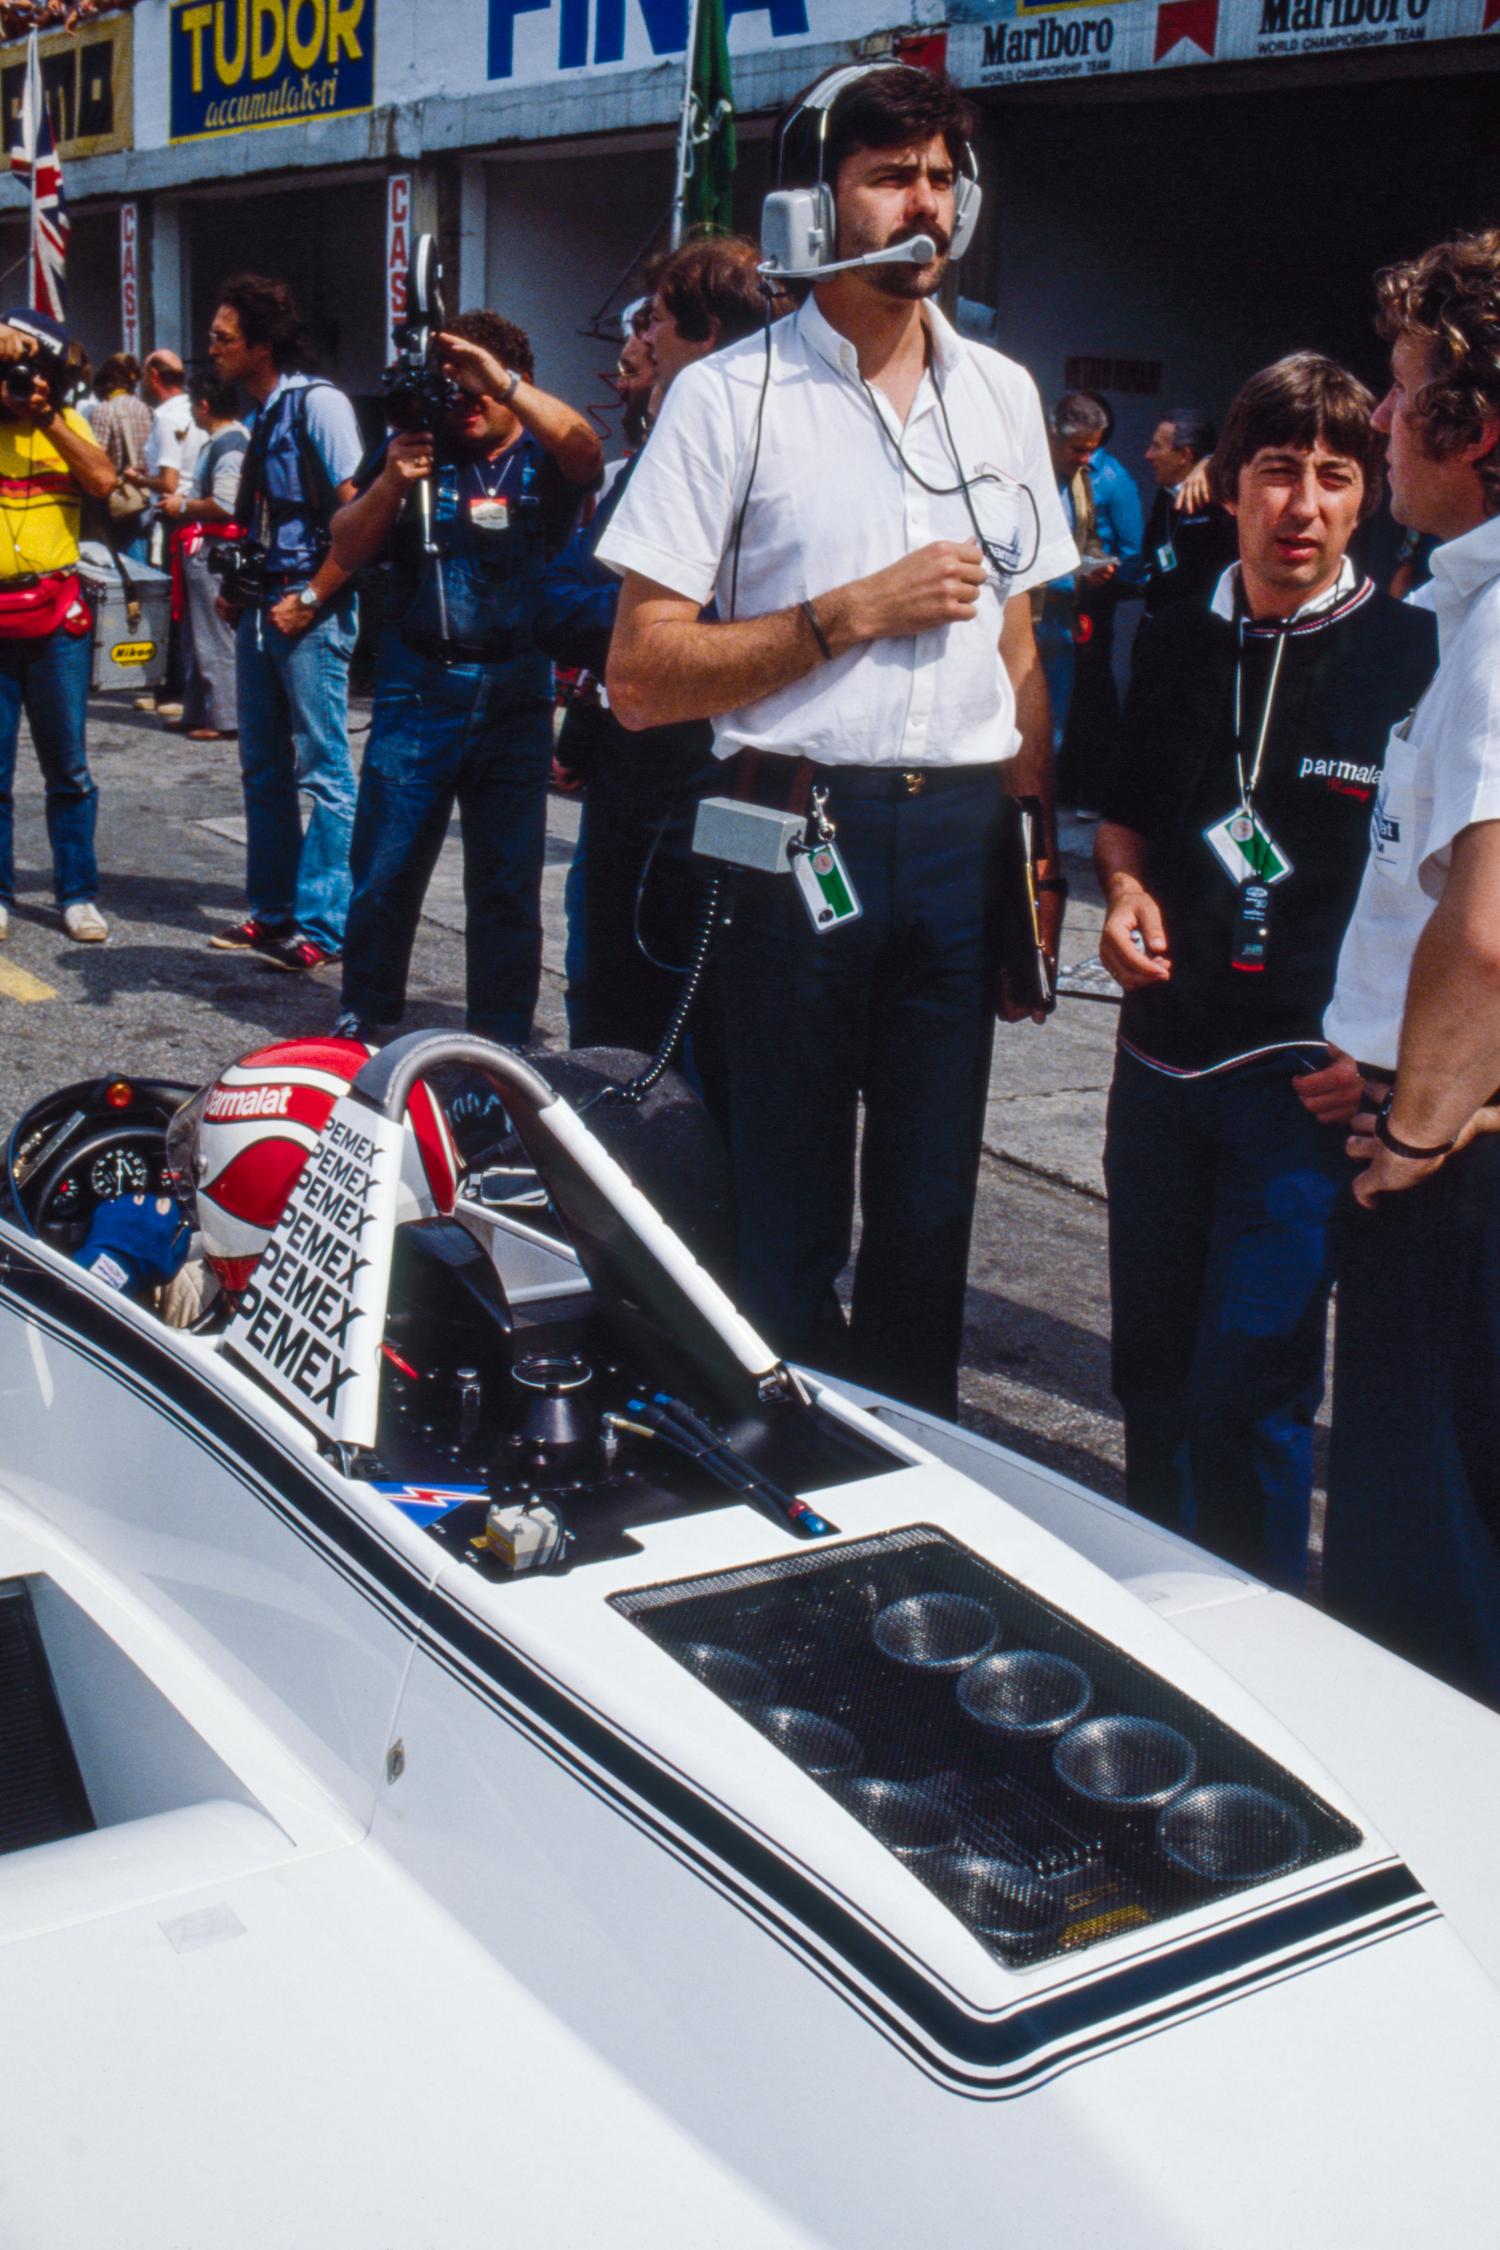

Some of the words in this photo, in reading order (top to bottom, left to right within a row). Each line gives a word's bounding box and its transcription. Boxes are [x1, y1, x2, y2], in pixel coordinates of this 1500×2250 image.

[182, 0, 363, 93] TUDOR
[982, 17, 1114, 67] Marlboro
[1257, 38, 1298, 54] WORLD
[1394, 26, 1426, 40] TEAM
[205, 68, 338, 127] accumulatori
[389, 179, 410, 325] CAS
[115, 647, 153, 658] Nikon
[204, 1086, 292, 1117] armalat
[311, 1141, 381, 1202] PEMEX
[323, 1116, 386, 1168] PEMEX
[295, 1170, 377, 1242] PEMEX
[278, 1202, 373, 1294] PEMEX
[259, 1237, 367, 1350] PEMEX
[235, 1281, 360, 1420] PEMEX
